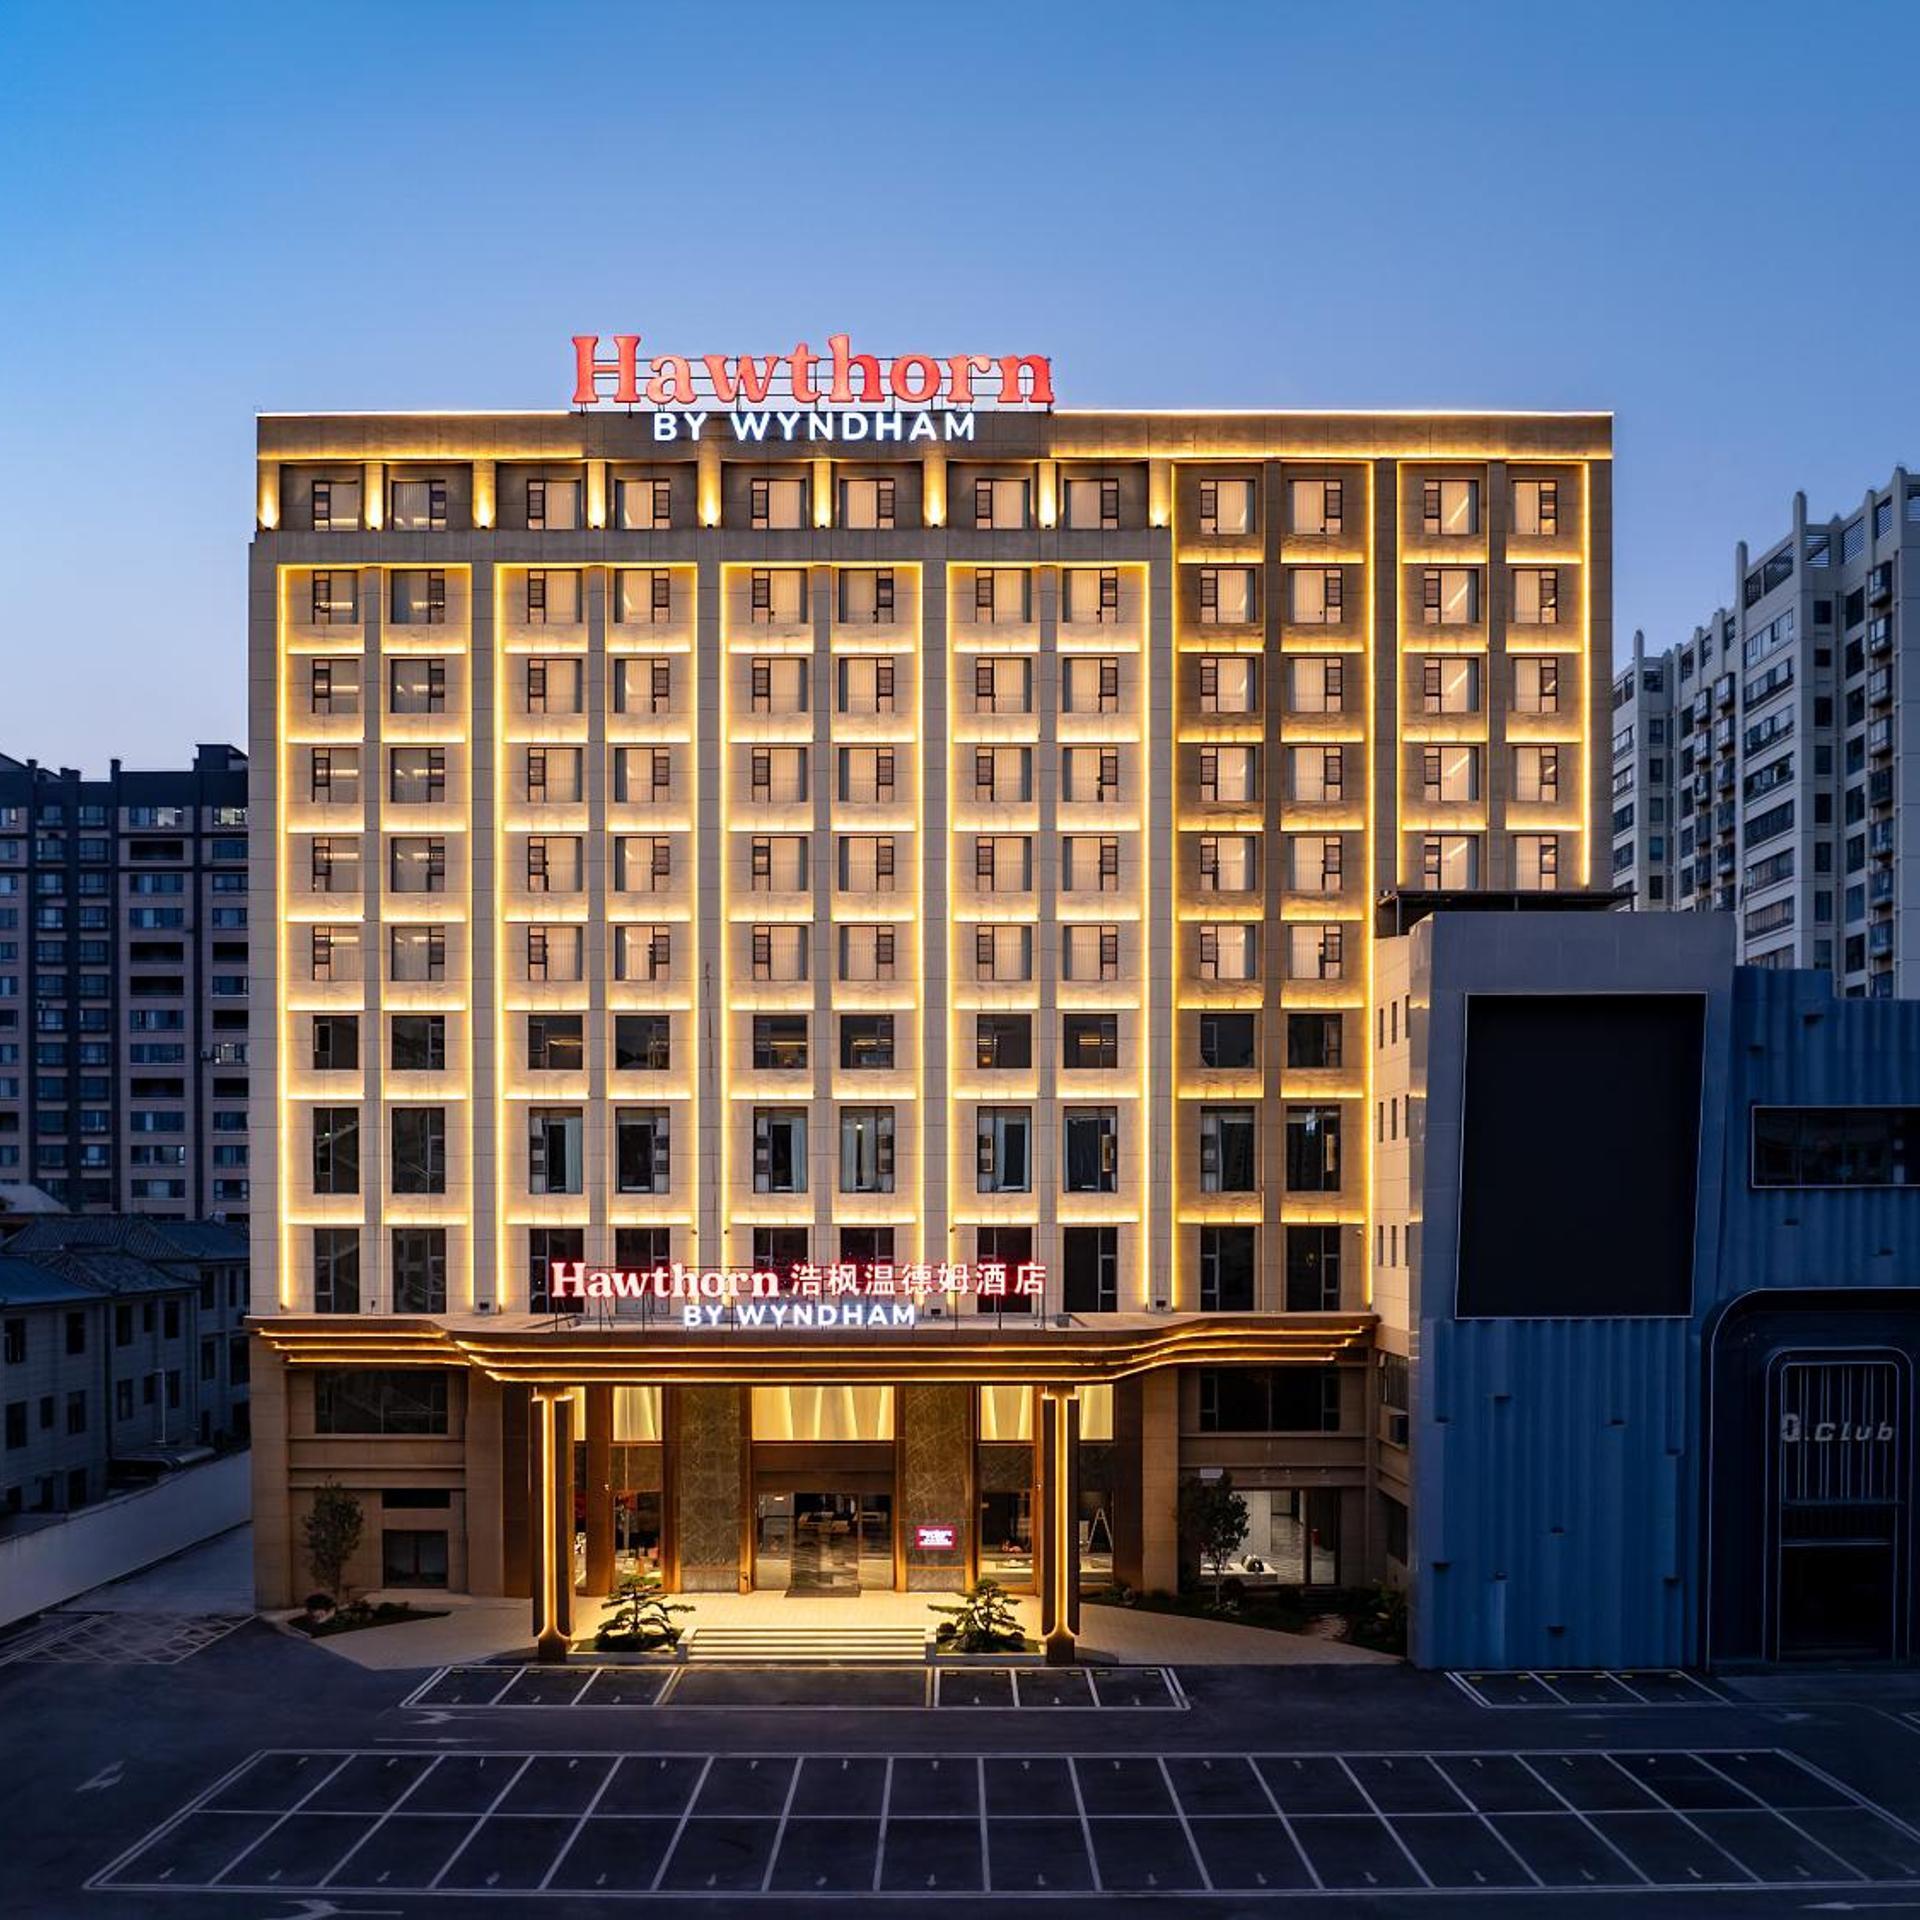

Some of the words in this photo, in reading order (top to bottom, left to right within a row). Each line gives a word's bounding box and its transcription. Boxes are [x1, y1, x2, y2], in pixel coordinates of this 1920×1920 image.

[572, 334, 1055, 404] Hawthorn
[653, 411, 707, 442] BY
[730, 411, 976, 442] WYNDHAM
[550, 1261, 780, 1299] Hawthorn
[790, 1262, 1047, 1297] 浩枫温德姆酒店
[682, 1303, 725, 1328] BY
[735, 1303, 917, 1328] WYNDHAM
